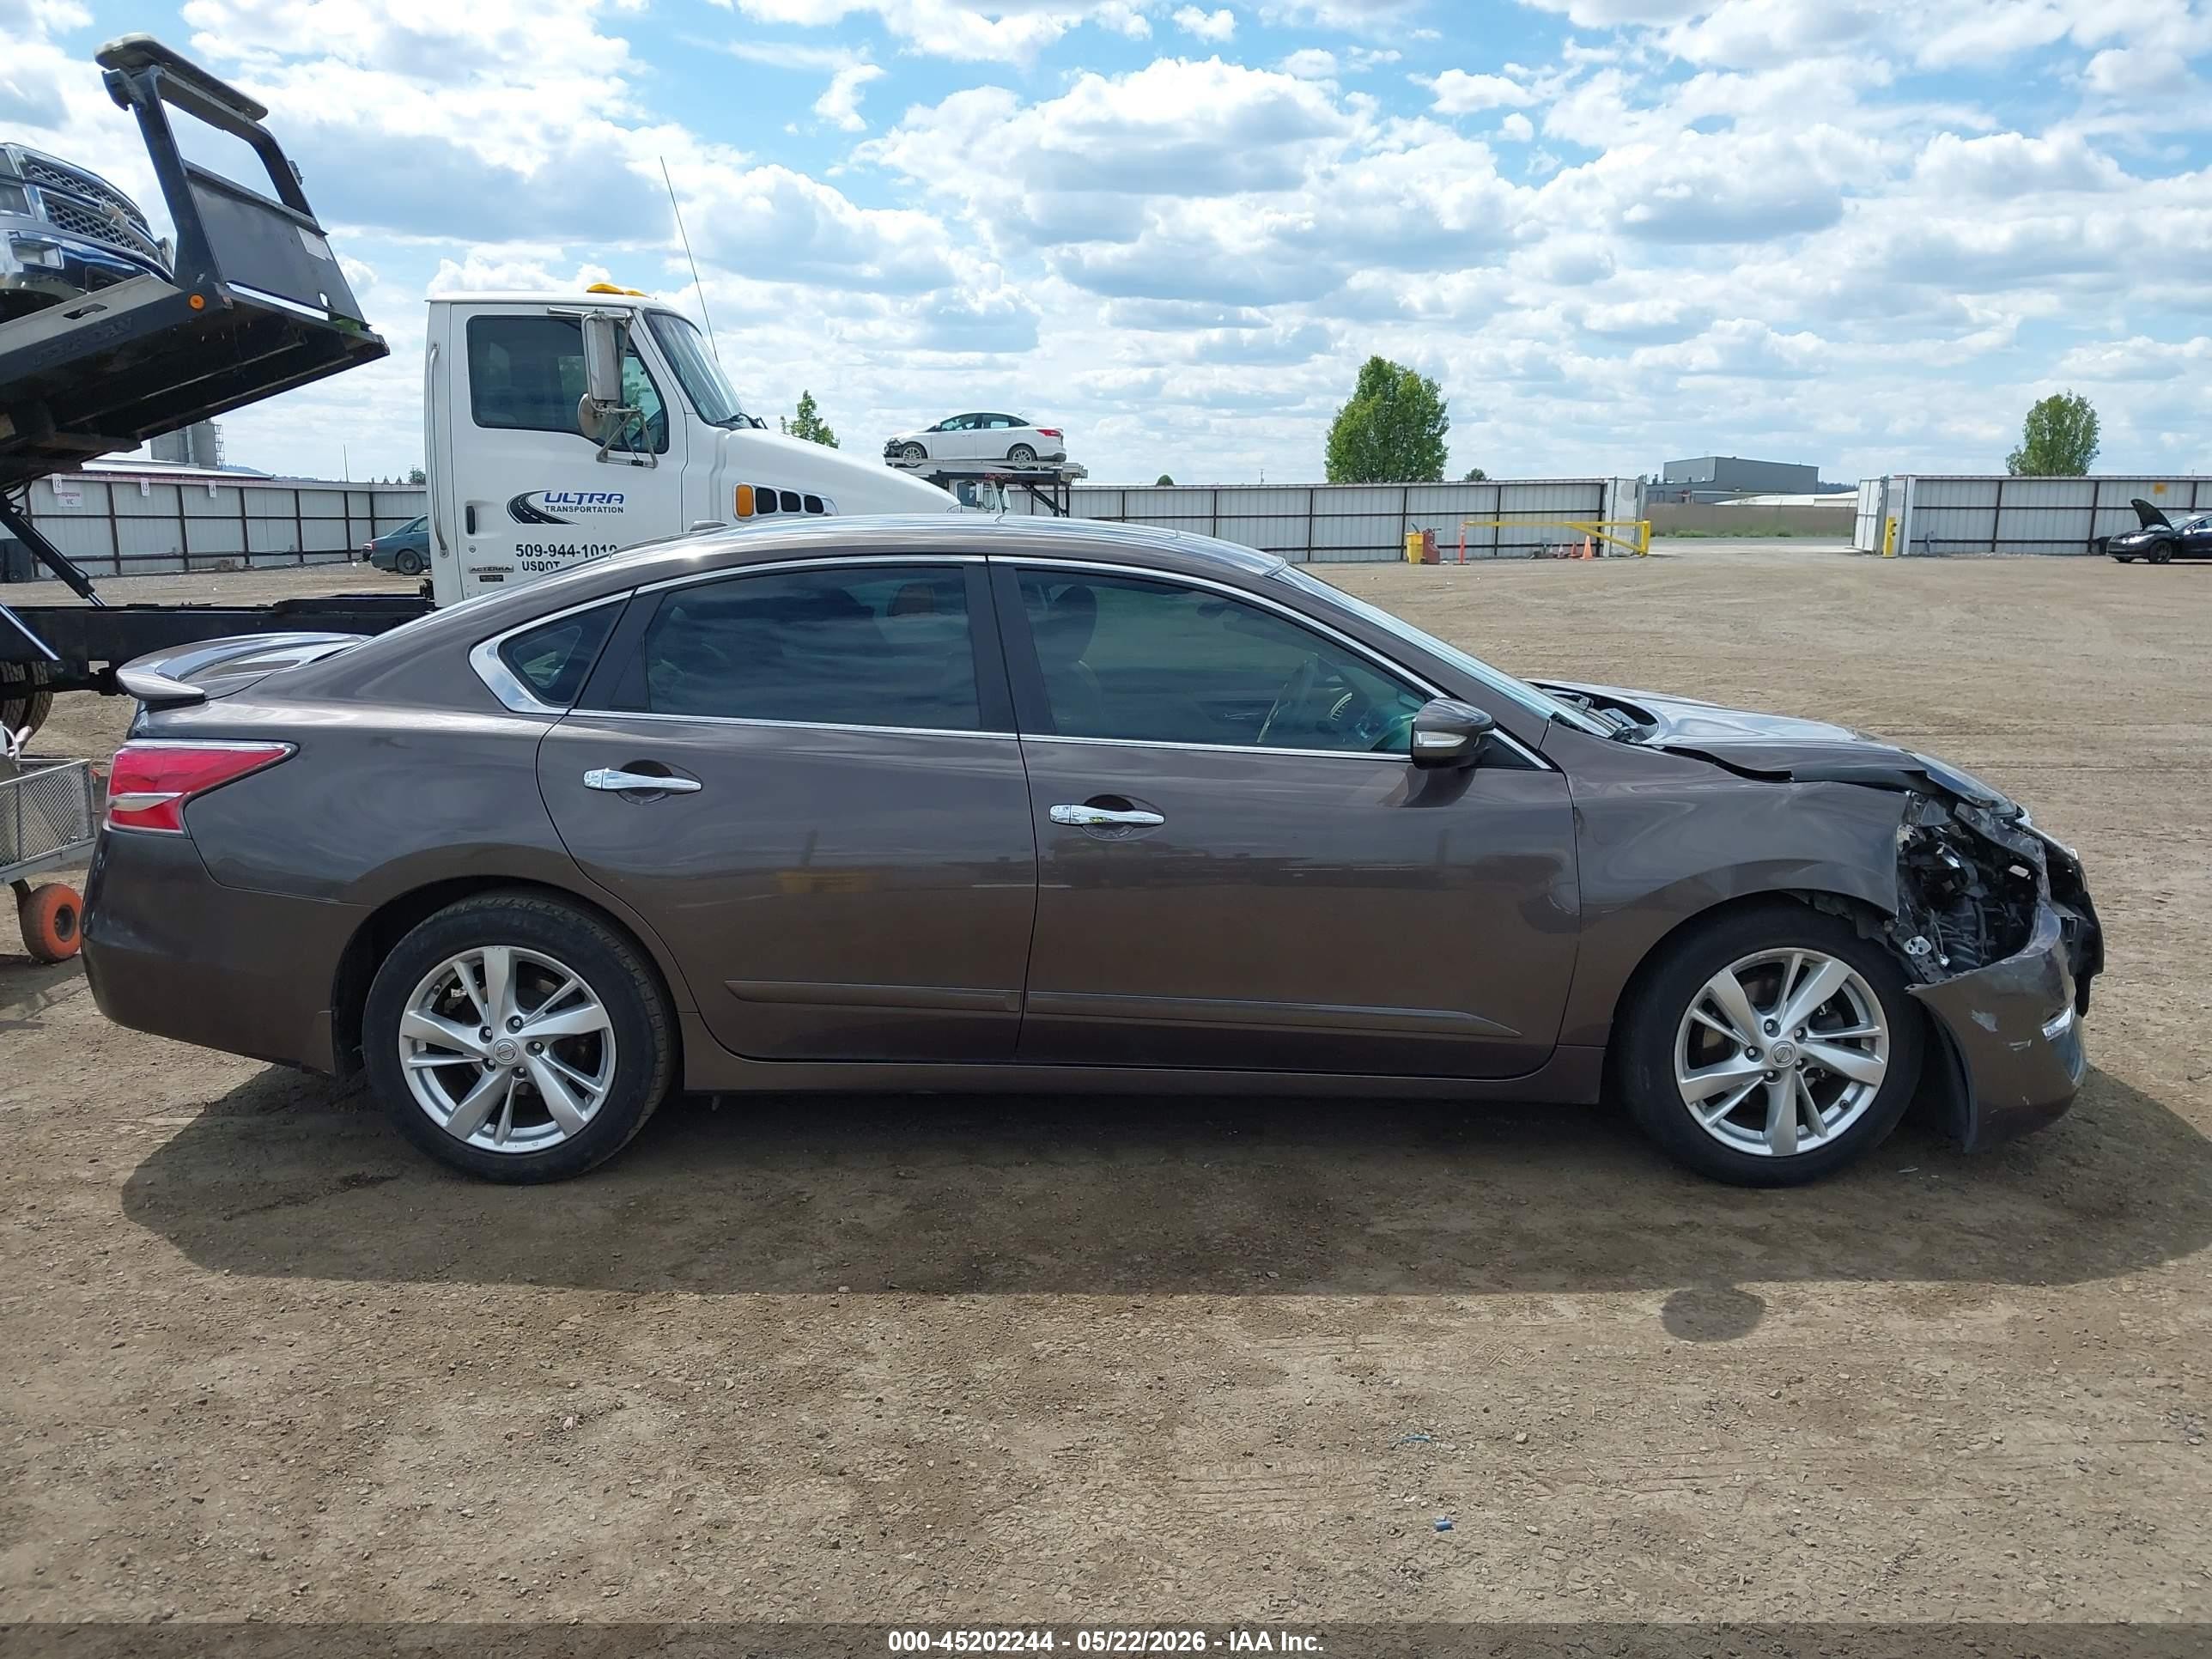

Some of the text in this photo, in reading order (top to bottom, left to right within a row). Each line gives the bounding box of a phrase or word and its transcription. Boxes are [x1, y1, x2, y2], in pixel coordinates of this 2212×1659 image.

[54, 479, 61, 488] 12
[544, 492, 624, 505] ULTRA
[544, 505, 624, 514] TRANSPORTATION
[521, 561, 560, 571] USDOT
